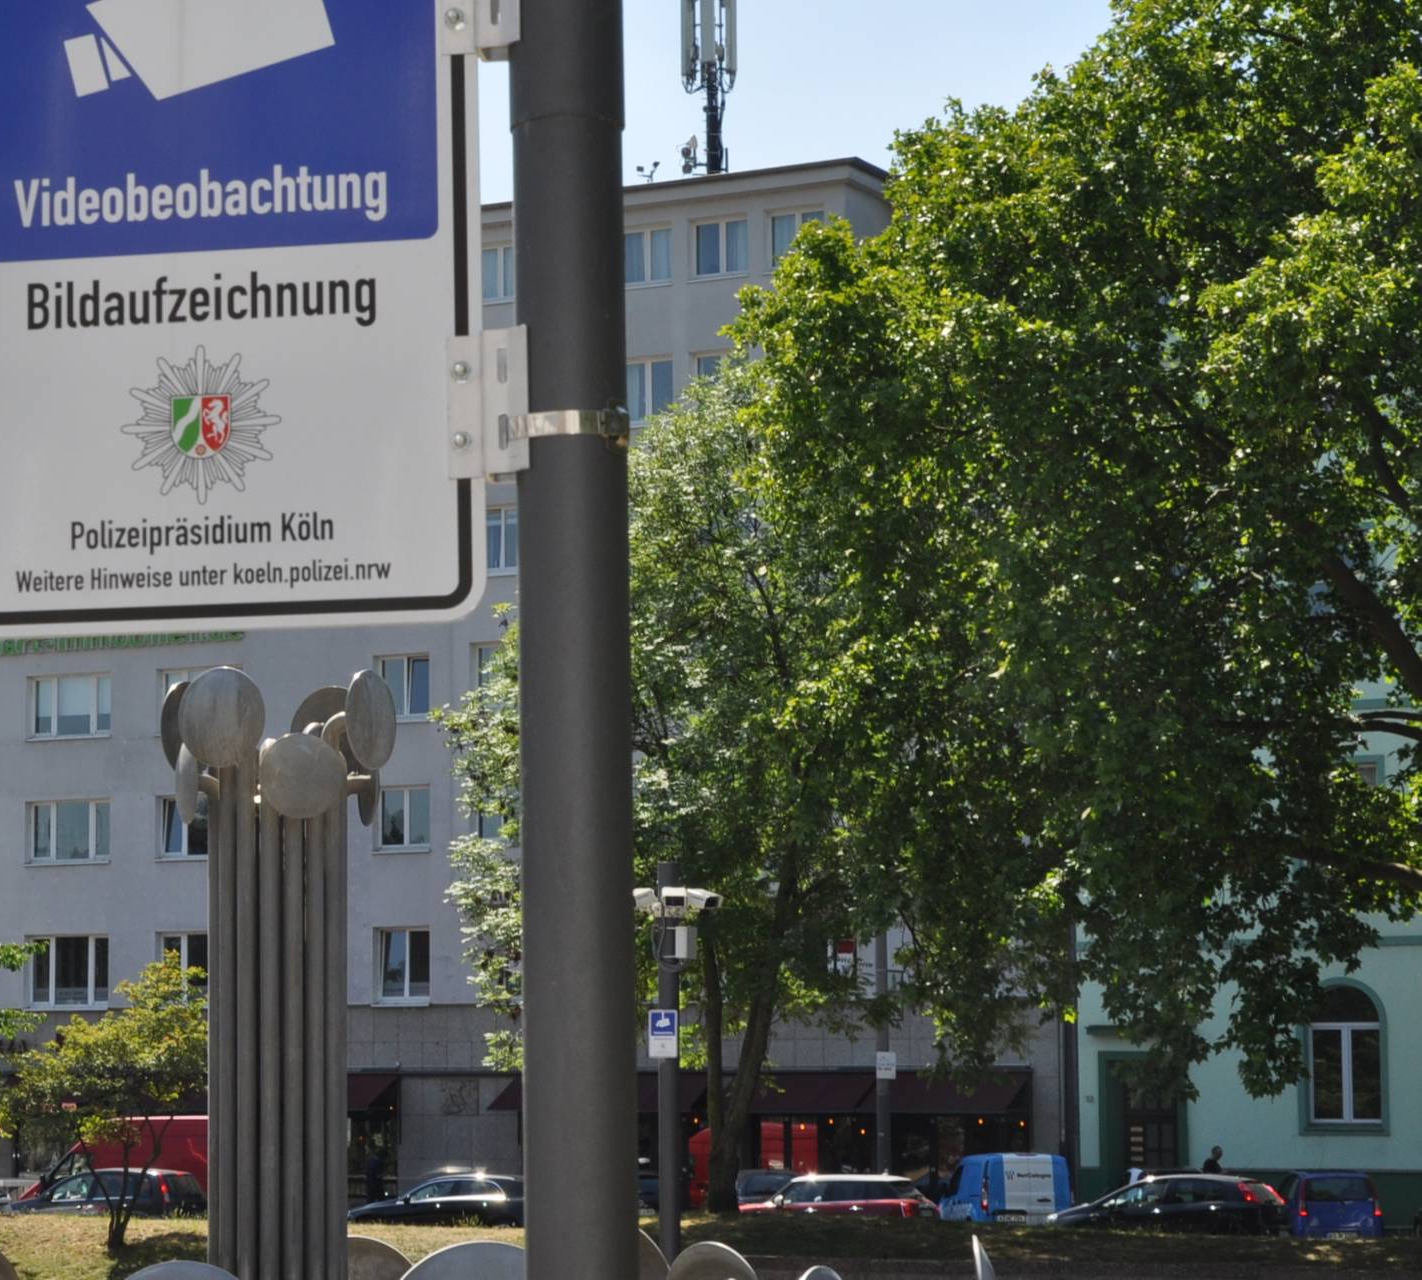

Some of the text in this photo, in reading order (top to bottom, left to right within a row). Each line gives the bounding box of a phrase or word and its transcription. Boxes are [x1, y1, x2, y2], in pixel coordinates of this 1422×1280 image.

[14, 164, 388, 228] Videobeobachtung
[27, 270, 377, 331] Bildaufzeichnung
[70, 511, 334, 556] Polizeipräsidium Köln
[15, 559, 391, 593] Weitere Hinweise unter koeln.polizei.nrw
